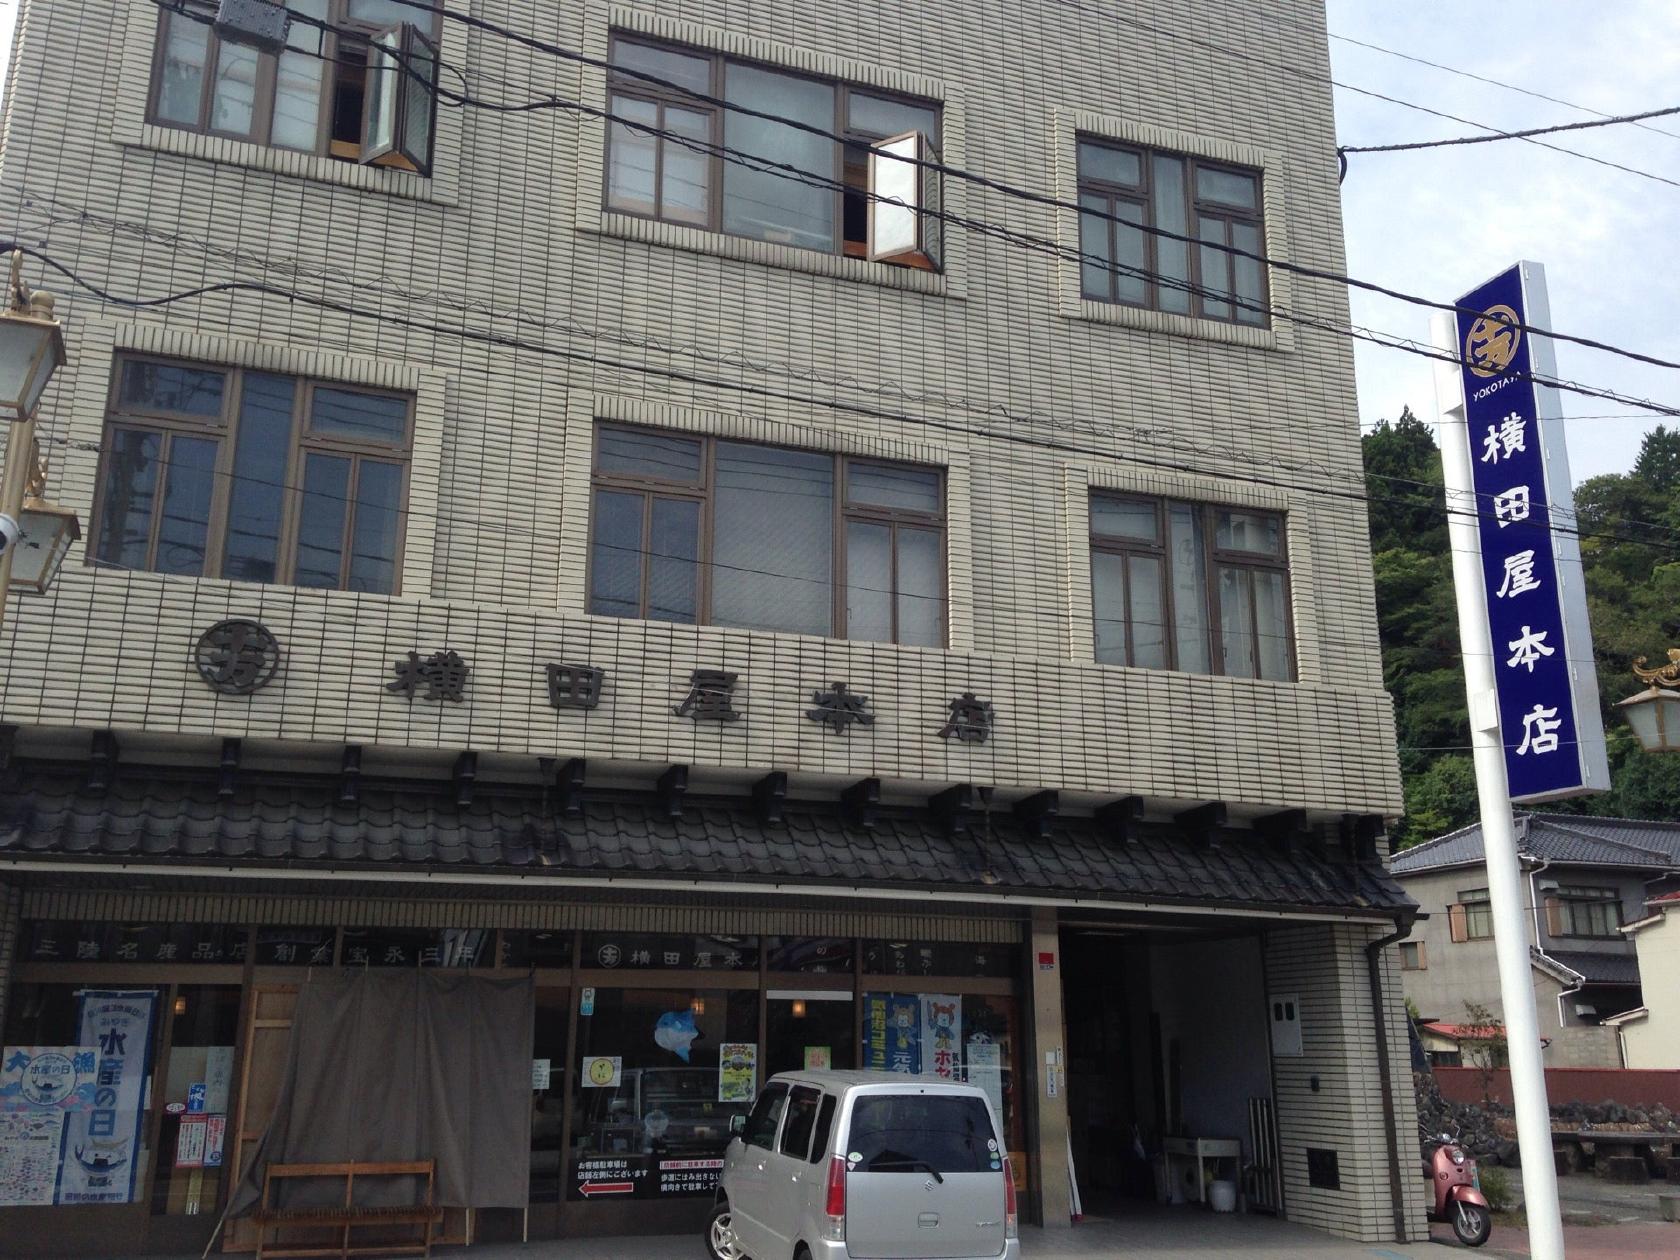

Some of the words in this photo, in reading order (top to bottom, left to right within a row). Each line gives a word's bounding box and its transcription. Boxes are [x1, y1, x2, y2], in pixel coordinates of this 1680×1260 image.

[1481, 411, 1563, 755] 横田屋本店
[386, 651, 994, 744] 横田屋本店
[630, 949, 758, 968] 横田屋本
[88, 1028, 128, 1136] 水産の日
[577, 1160, 628, 1170] お客様駐車場は
[577, 1169, 649, 1180] 店舗左側にございます
[660, 1182, 718, 1192] 横向きで駐車して
